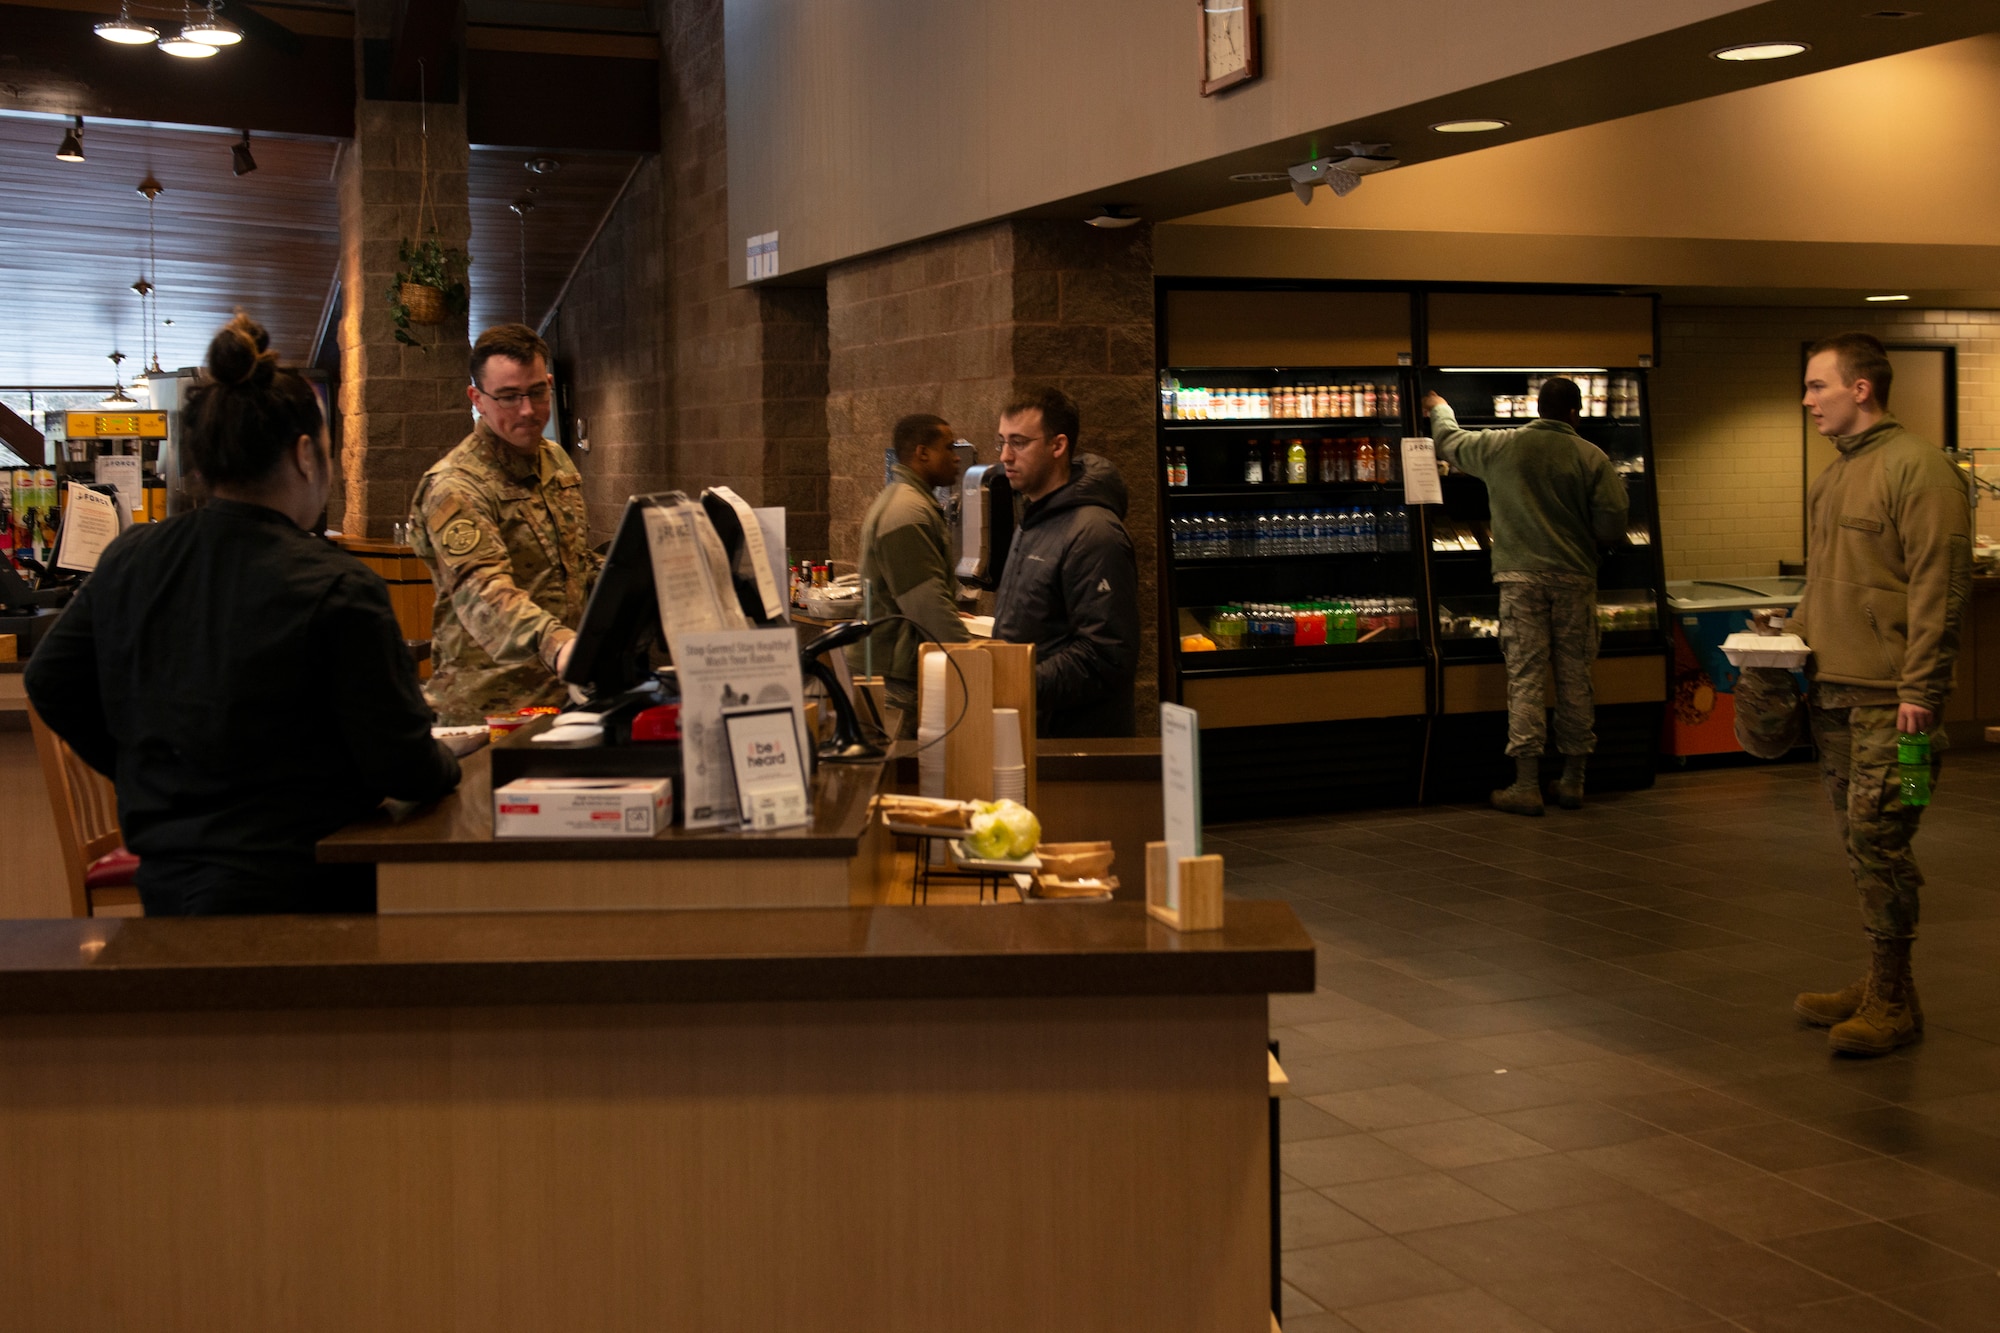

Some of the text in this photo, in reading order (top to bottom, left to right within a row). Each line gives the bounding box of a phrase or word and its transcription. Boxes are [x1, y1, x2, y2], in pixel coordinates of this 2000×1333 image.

[685, 645, 704, 658] Stop
[737, 642, 755, 654] Stay
[705, 653, 775, 666] Wash Your Hands
[755, 741, 773, 754] be
[747, 752, 786, 768] heard
